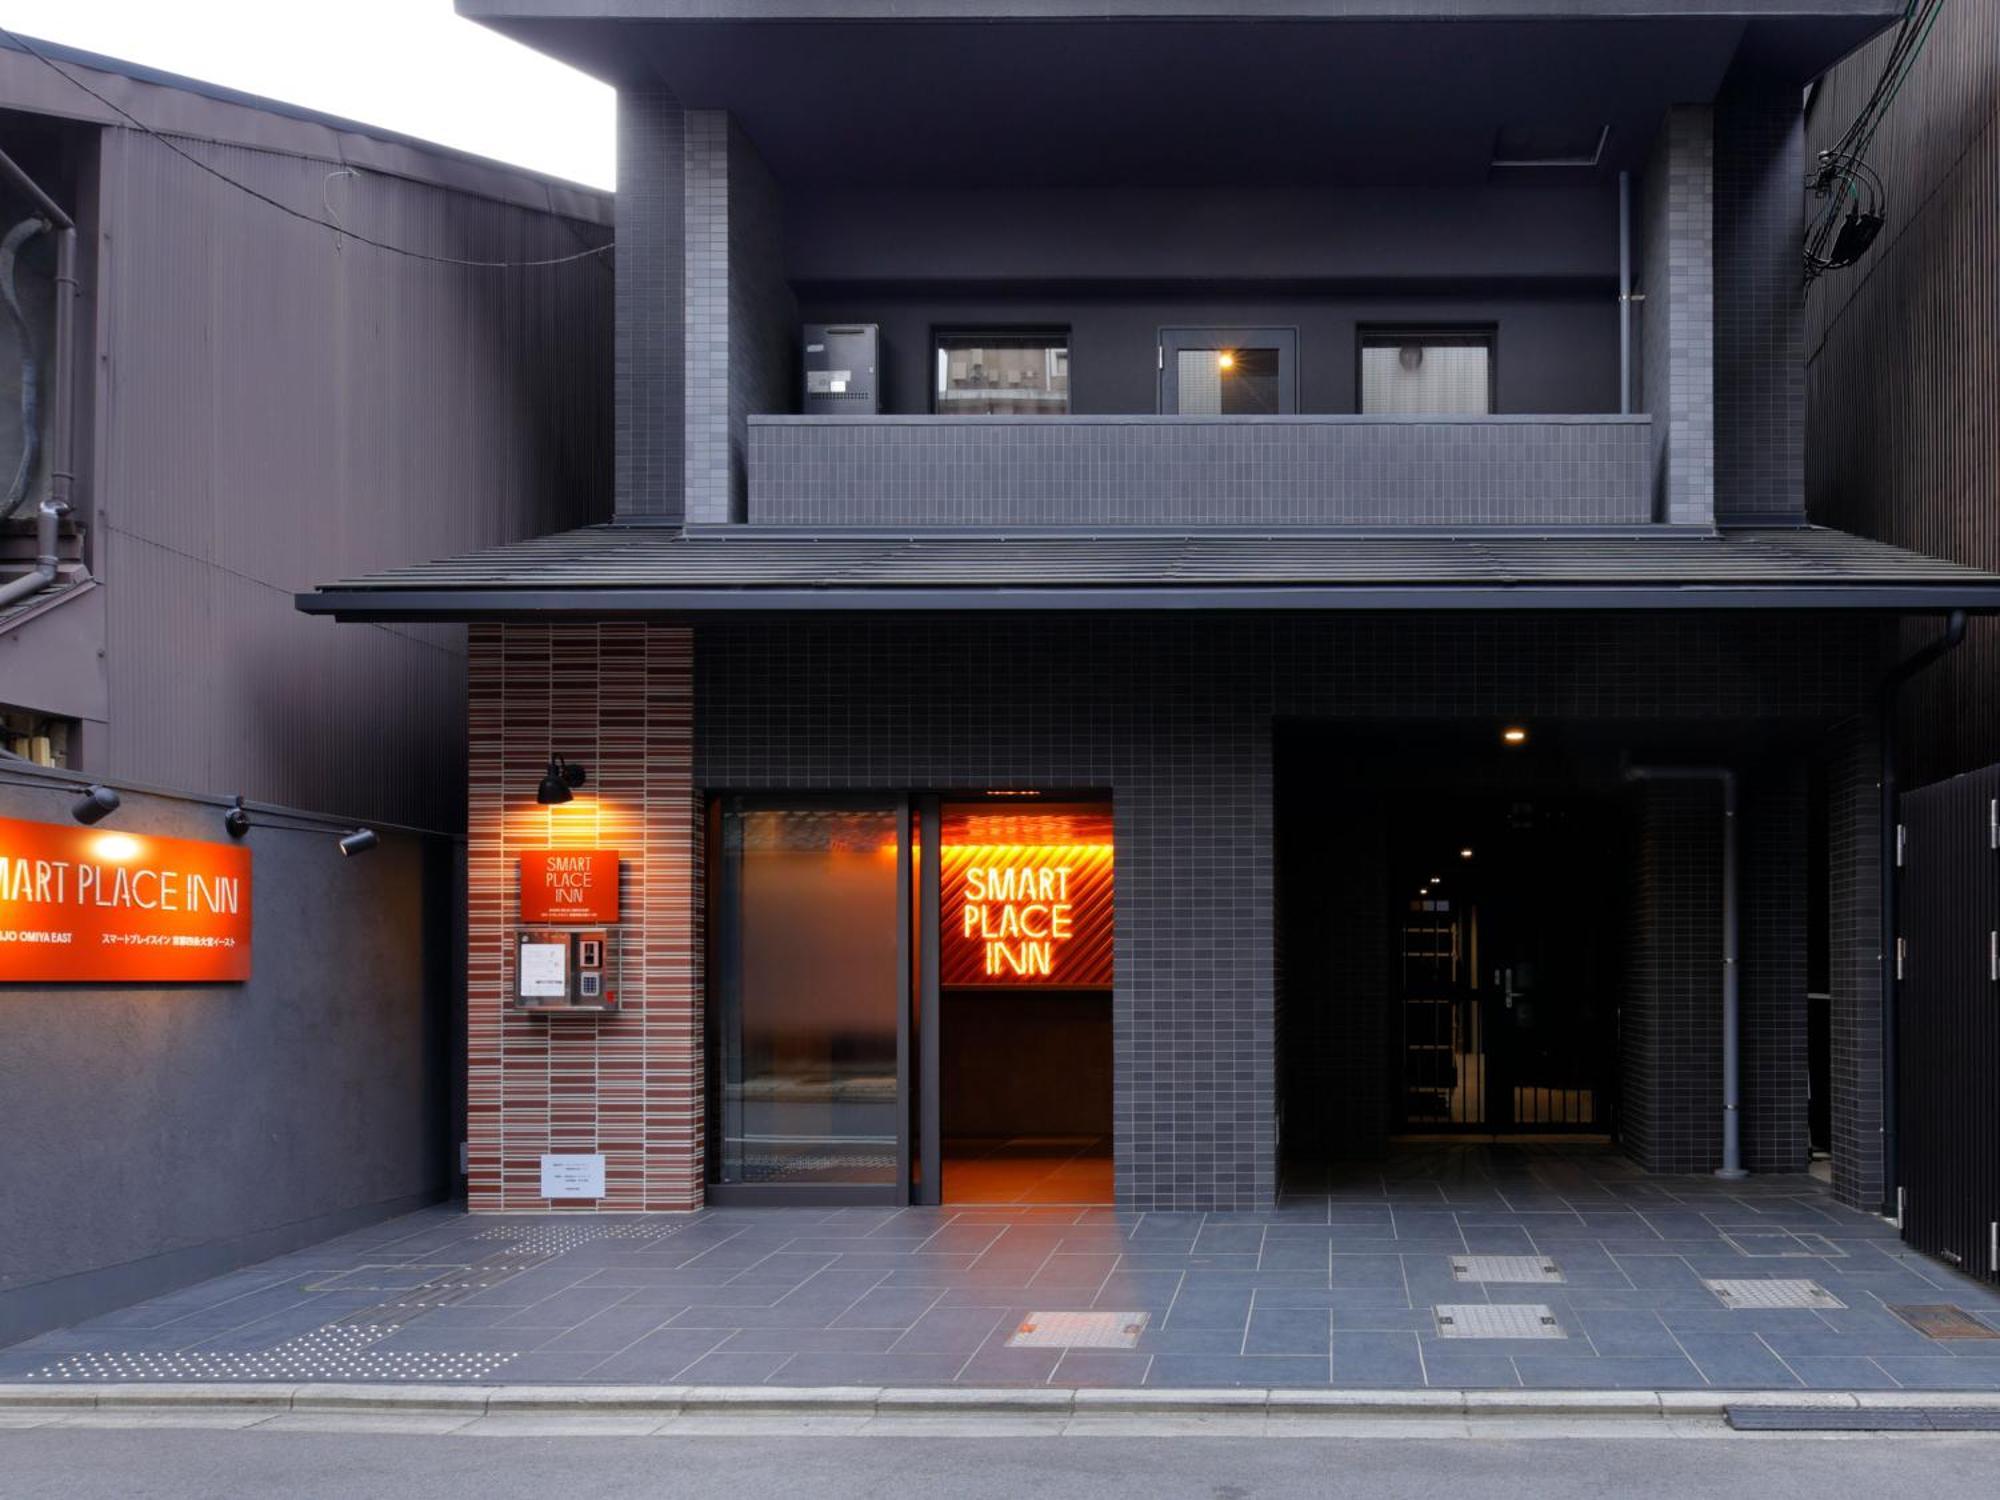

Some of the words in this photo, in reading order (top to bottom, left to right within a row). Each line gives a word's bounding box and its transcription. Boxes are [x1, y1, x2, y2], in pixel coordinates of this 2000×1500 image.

[546, 856, 592, 872] SMART
[78, 864, 178, 911] PLACE
[187, 875, 239, 914] INN
[546, 872, 592, 887] PLACE
[964, 866, 1073, 901] SMART
[555, 888, 583, 902] INN
[964, 904, 1073, 939] PLACE
[19, 931, 51, 943] OMIYA
[51, 932, 72, 944] EAST
[985, 941, 1051, 976] INN
